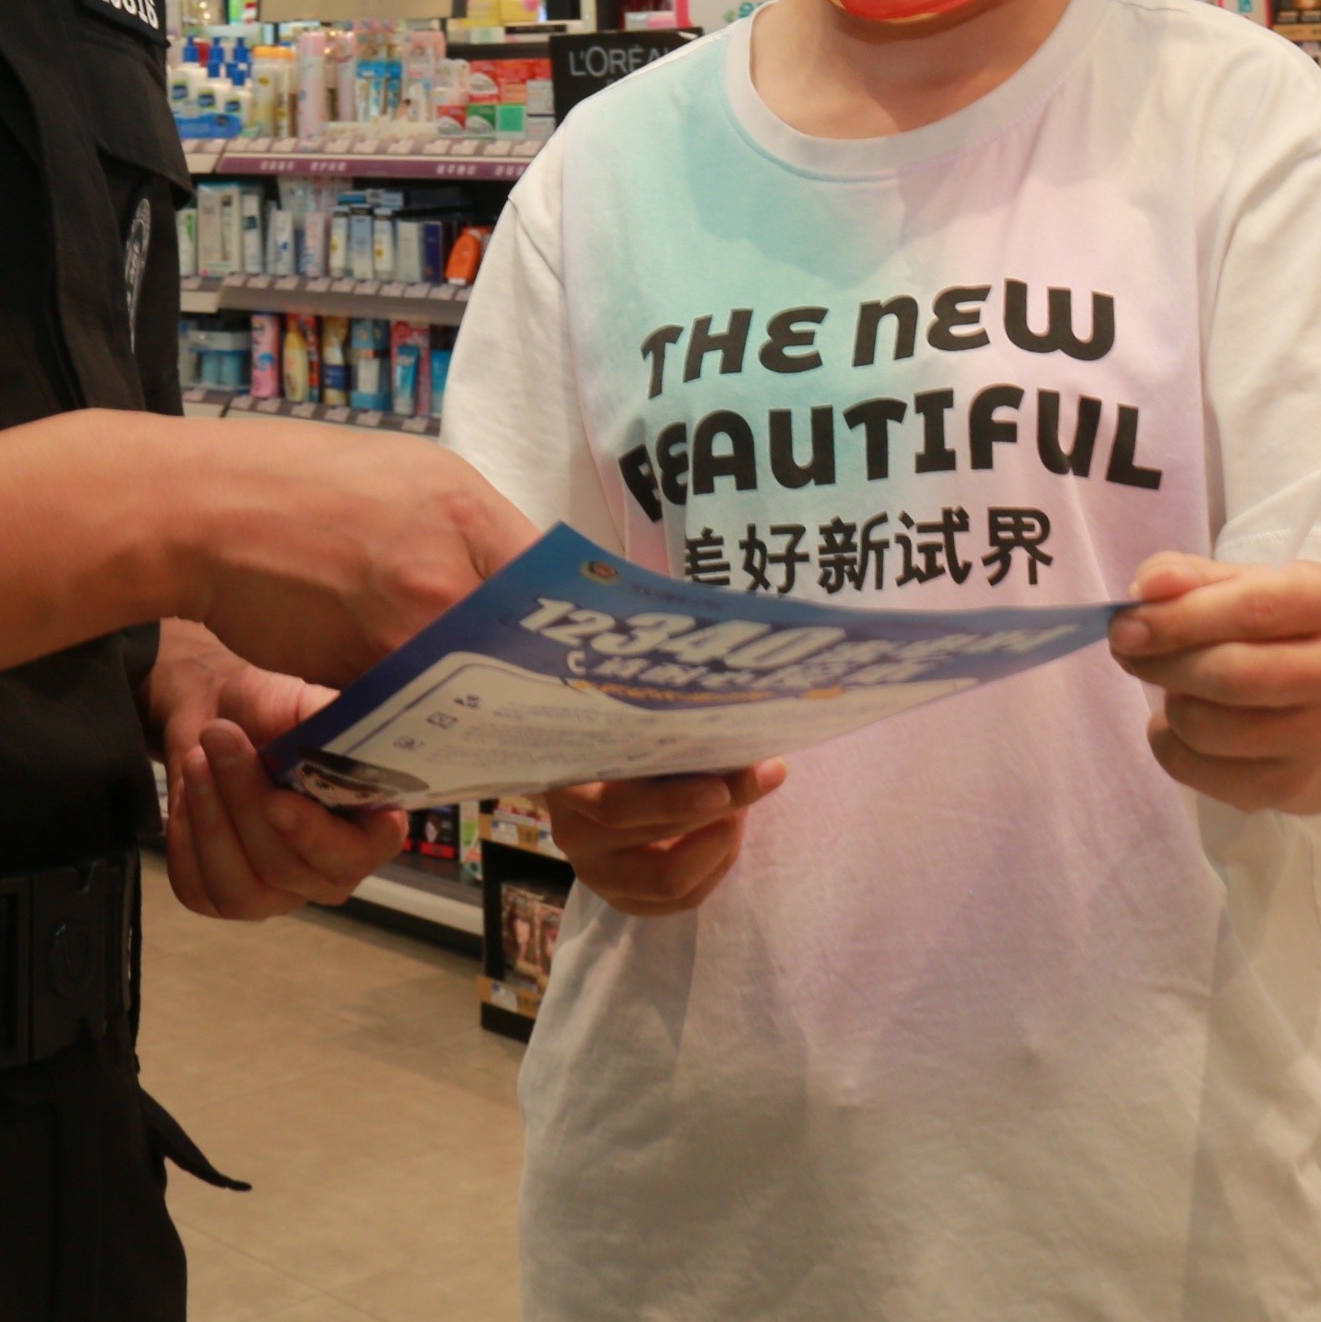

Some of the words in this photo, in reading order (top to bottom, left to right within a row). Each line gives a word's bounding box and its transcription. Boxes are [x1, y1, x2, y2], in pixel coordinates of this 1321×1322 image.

[568, 44, 671, 77] L'ORÉA
[640, 305, 828, 399] THE
[519, 597, 846, 670] 12340
